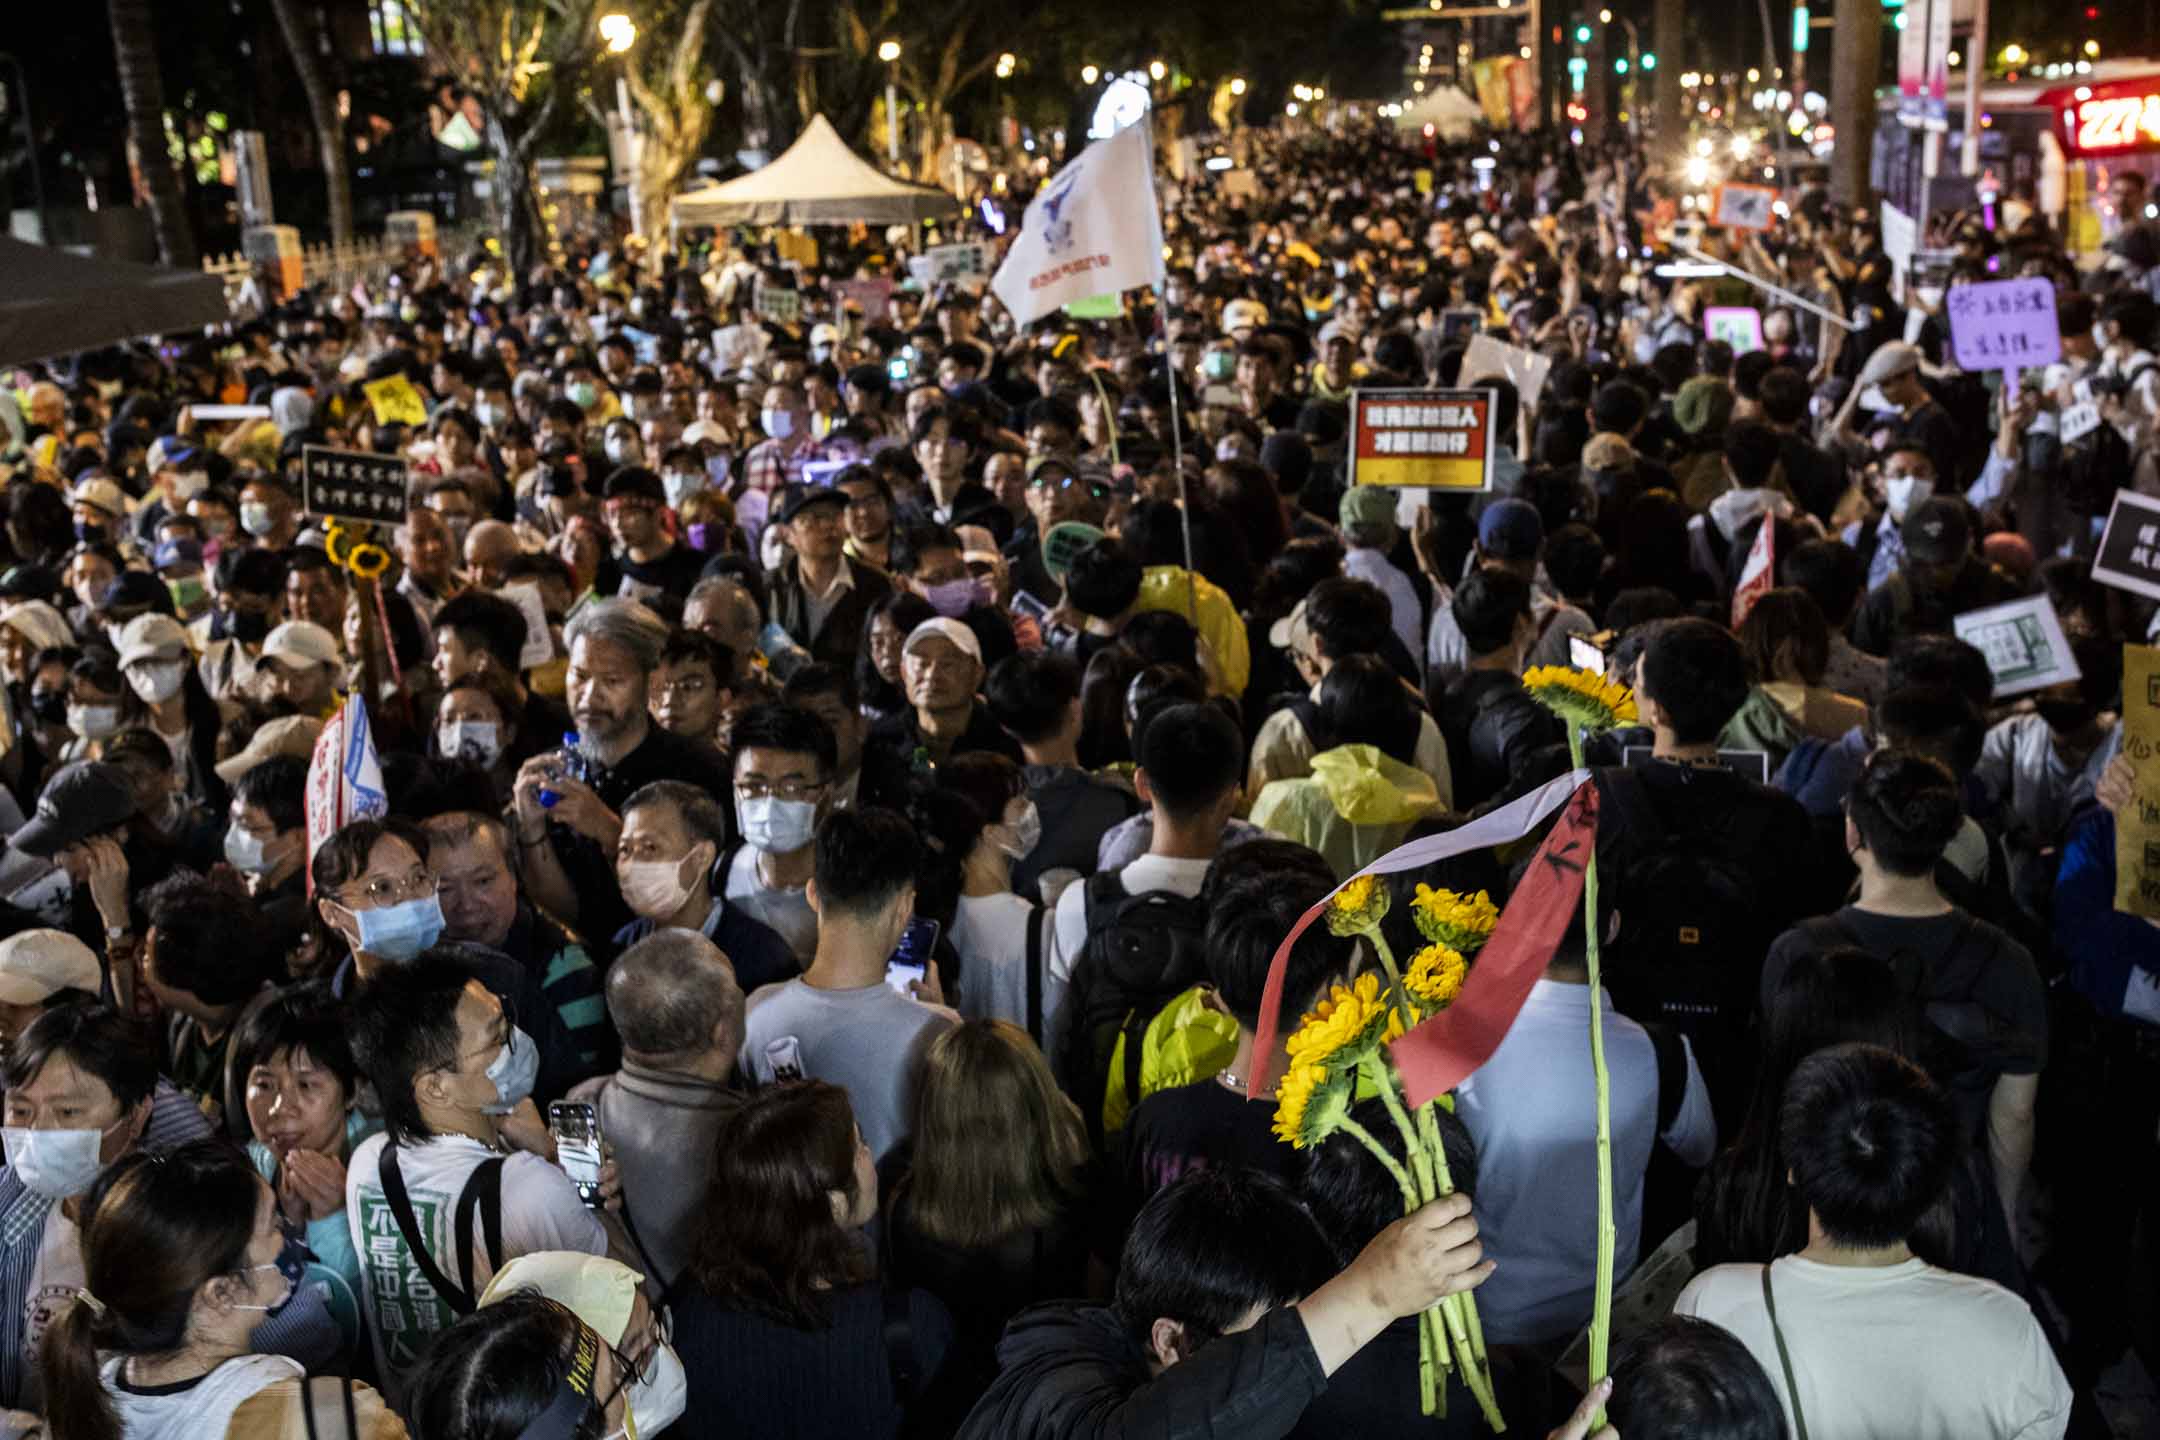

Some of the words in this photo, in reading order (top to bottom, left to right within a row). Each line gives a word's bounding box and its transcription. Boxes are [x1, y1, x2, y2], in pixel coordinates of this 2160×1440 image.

[368, 1203, 416, 1360] 不是中國人
